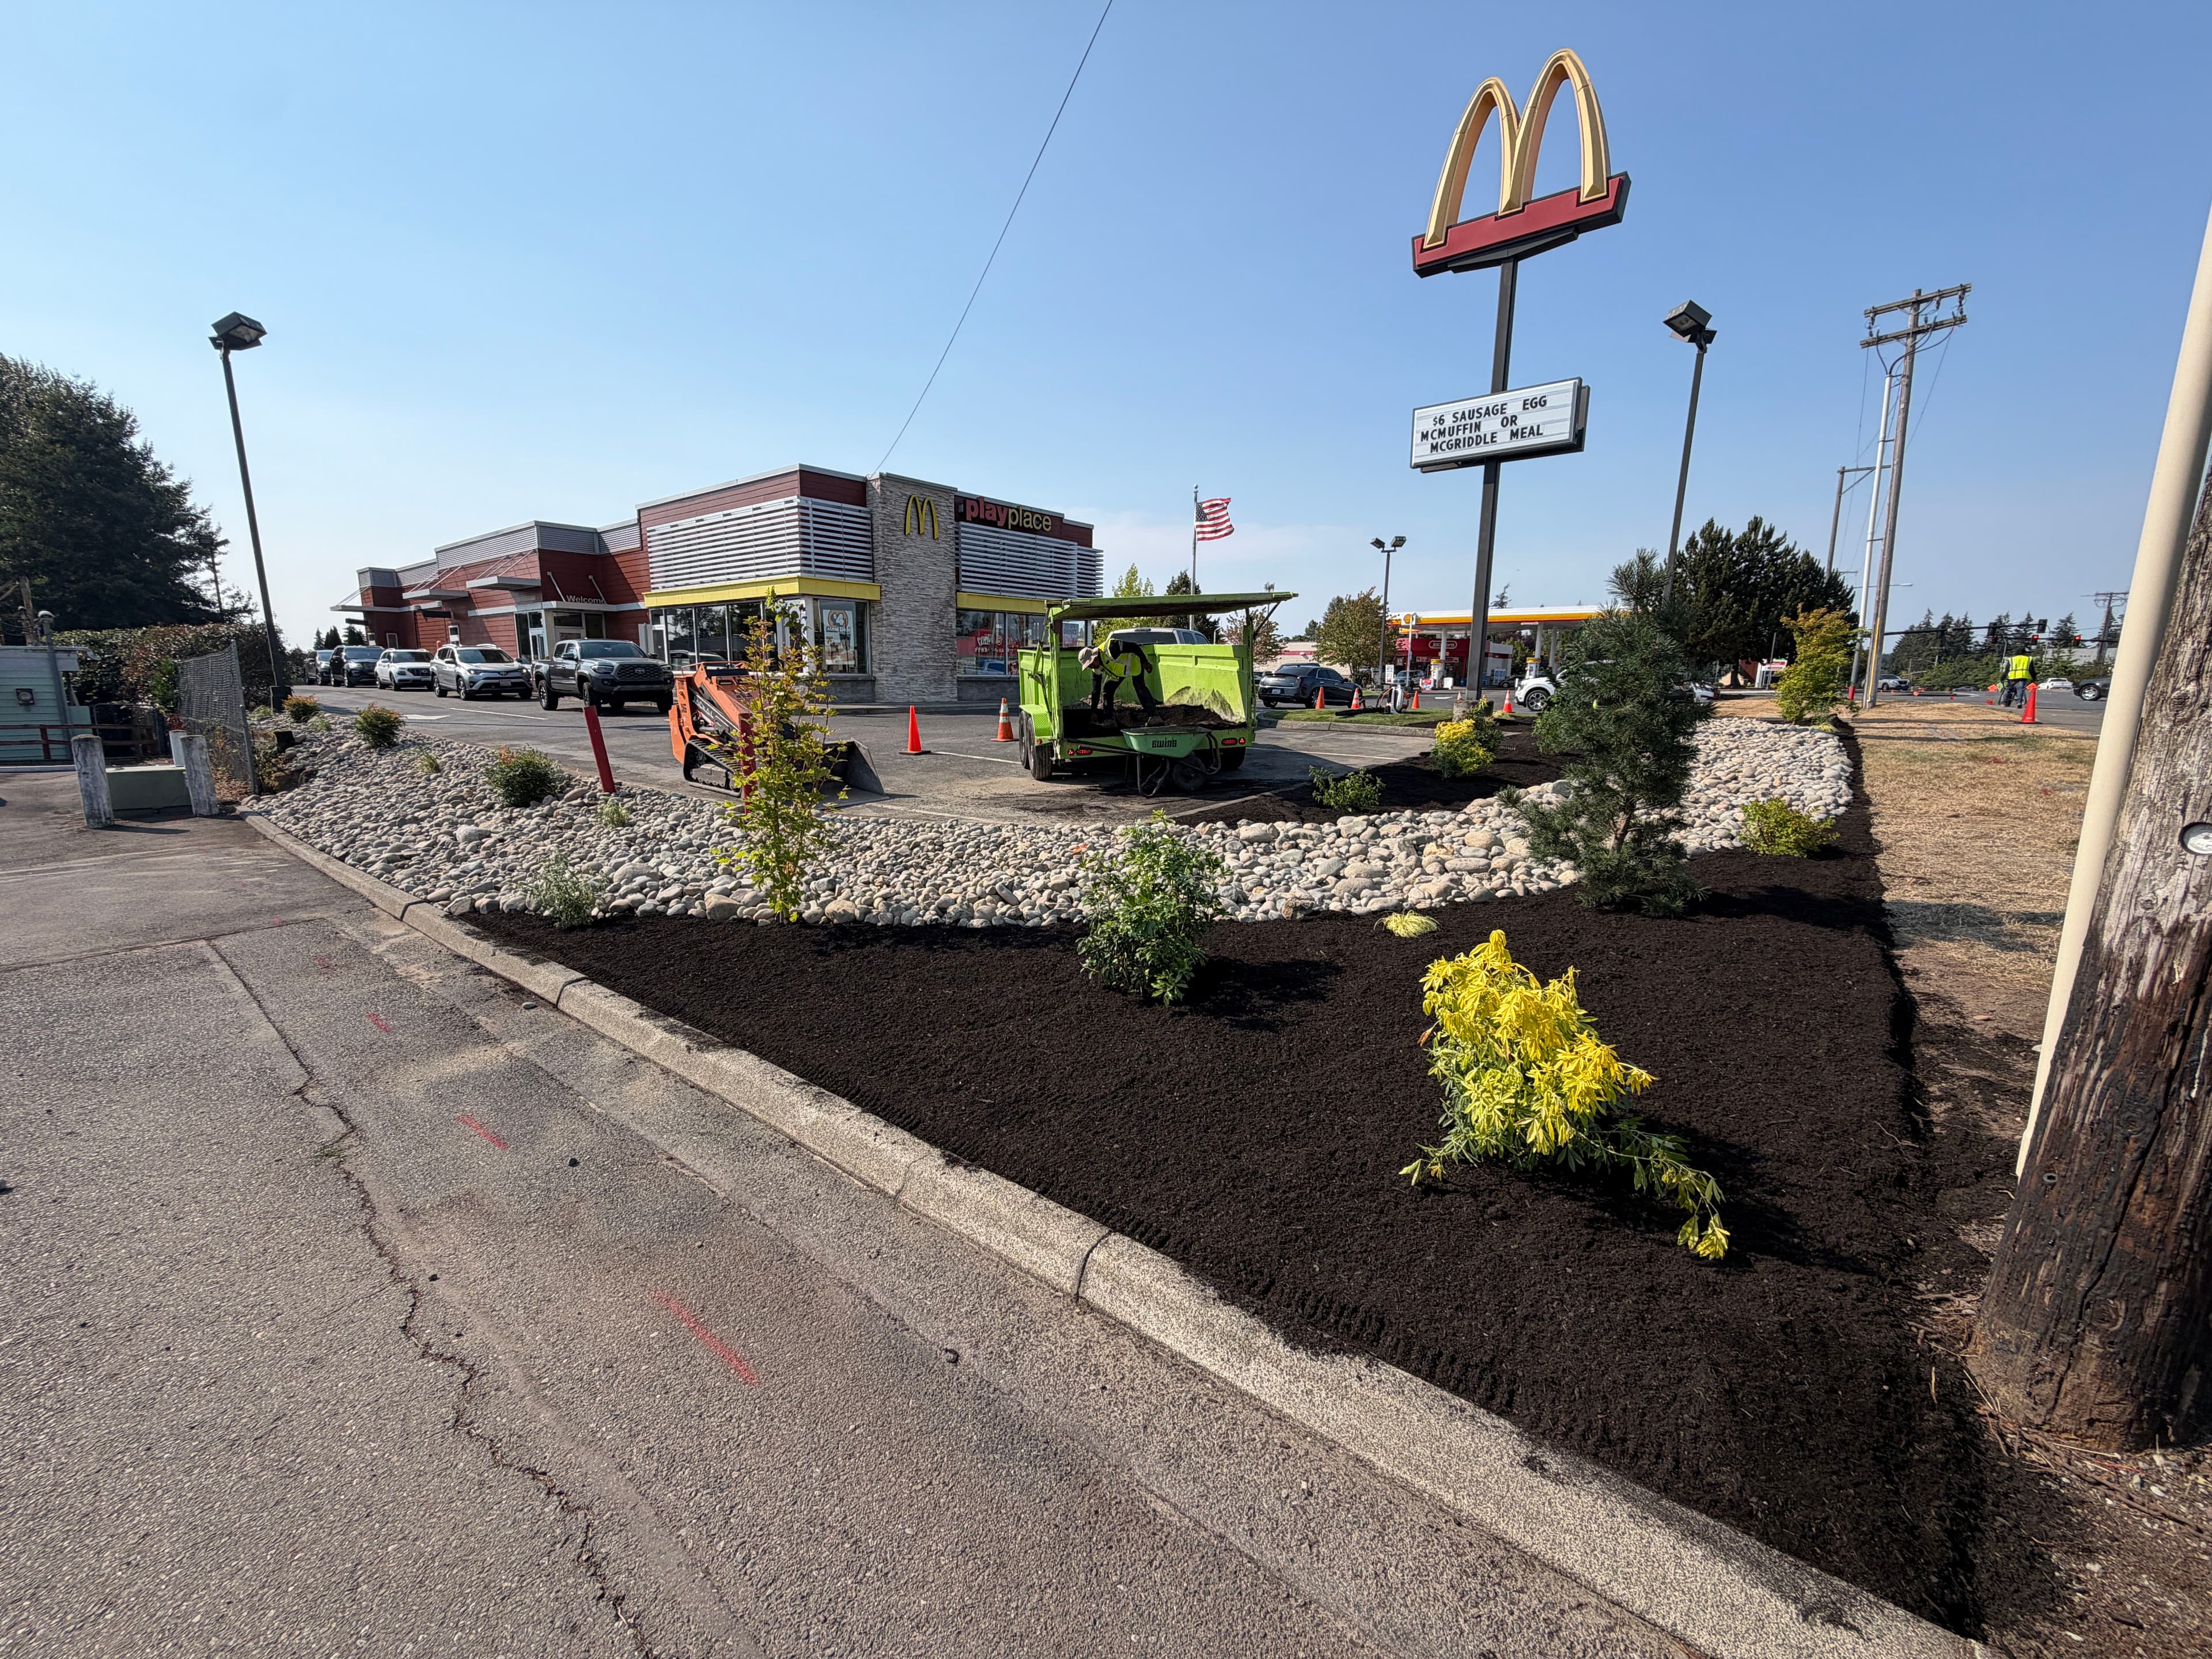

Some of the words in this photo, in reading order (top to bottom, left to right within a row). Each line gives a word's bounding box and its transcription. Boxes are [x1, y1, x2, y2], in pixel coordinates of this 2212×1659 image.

[1433, 414, 1445, 426] $6
[1452, 403, 1508, 423] SAUSAGE
[1522, 395, 1547, 410] EGG
[1421, 421, 1481, 442] MCMUFFIN
[1501, 415, 1517, 428] OR
[1430, 432, 1497, 453] MCGRIDDLE
[1510, 425, 1543, 440] MEAL
[566, 594, 607, 604] Welcome
